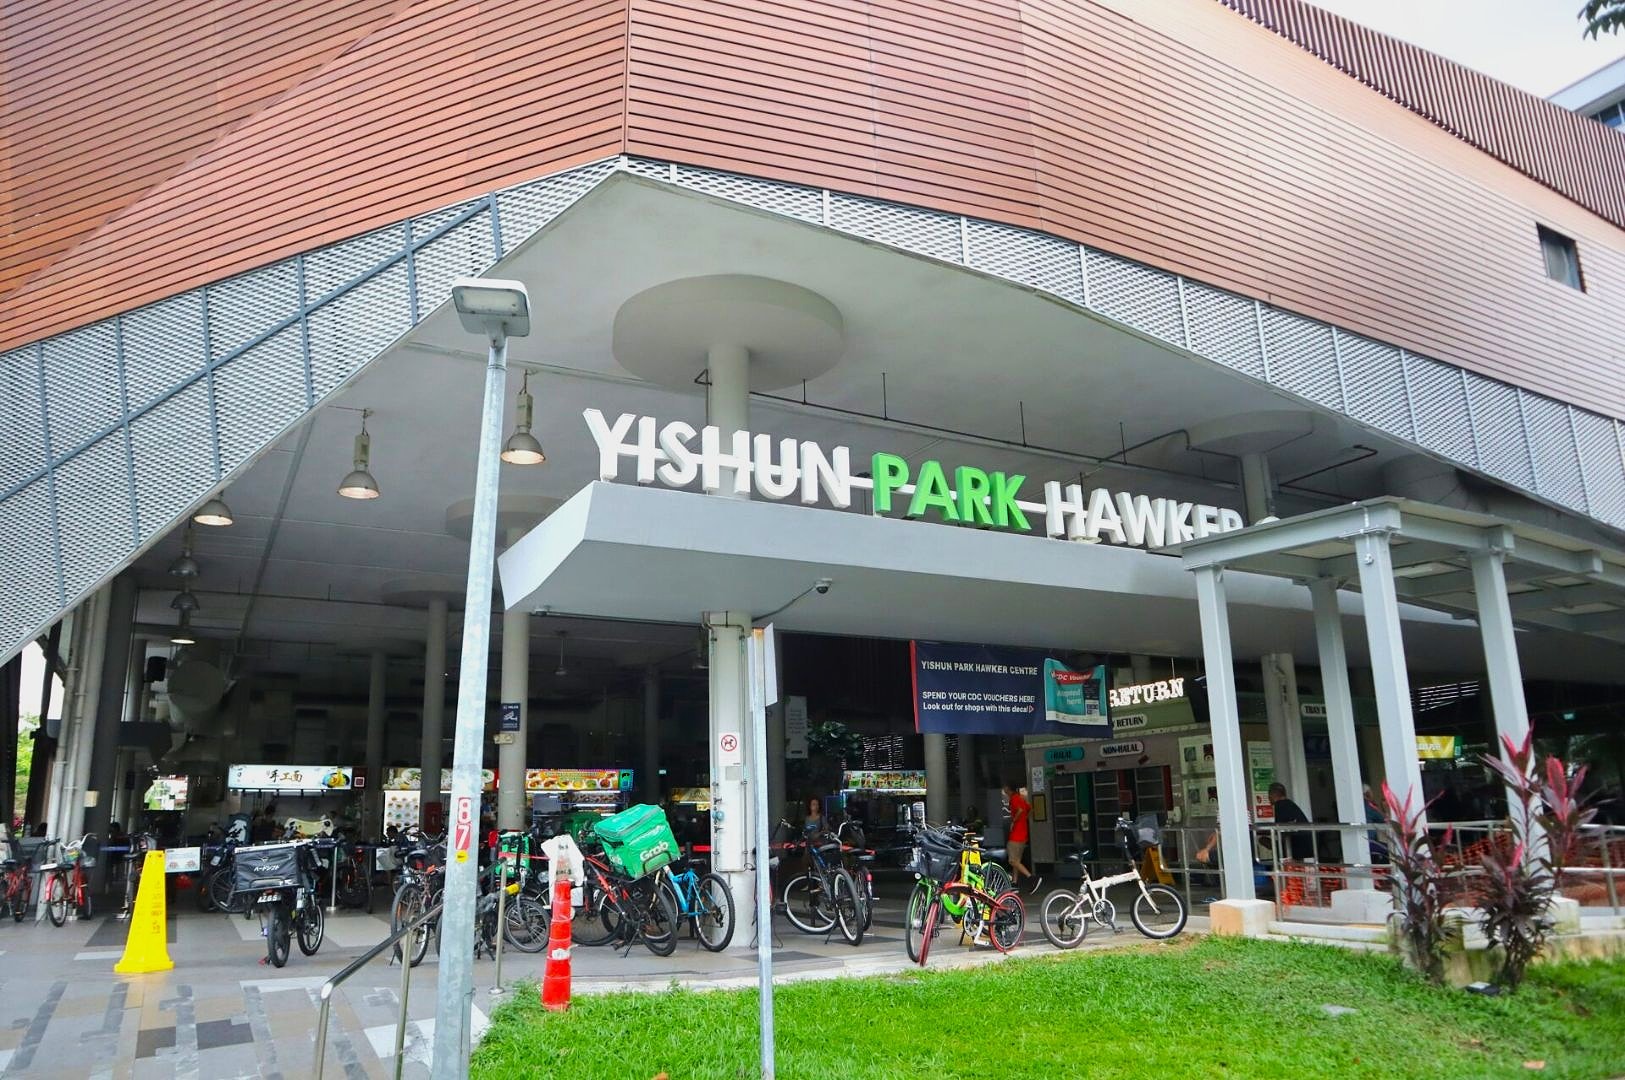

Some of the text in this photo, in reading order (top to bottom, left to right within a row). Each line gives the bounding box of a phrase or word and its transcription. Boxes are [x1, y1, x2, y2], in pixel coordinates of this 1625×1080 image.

[583, 408, 850, 508] YISHUN
[872, 452, 1031, 529] PARK
[921, 660, 1038, 676] YISHUN PARK HAWKER CENTRE
[922, 691, 946, 700] SPEND
[948, 692, 966, 701] YOUR
[967, 693, 982, 701] CDC
[983, 694, 1017, 702] VOUCHERS
[1109, 677, 1184, 708] RETURN
[923, 702, 940, 710] Look
[954, 703, 963, 711] for
[964, 704, 984, 713] shops
[998, 704, 1010, 712] this
[1011, 705, 1028, 713] decal
[1116, 716, 1143, 727] RETURN
[640, 841, 668, 862] Grab
